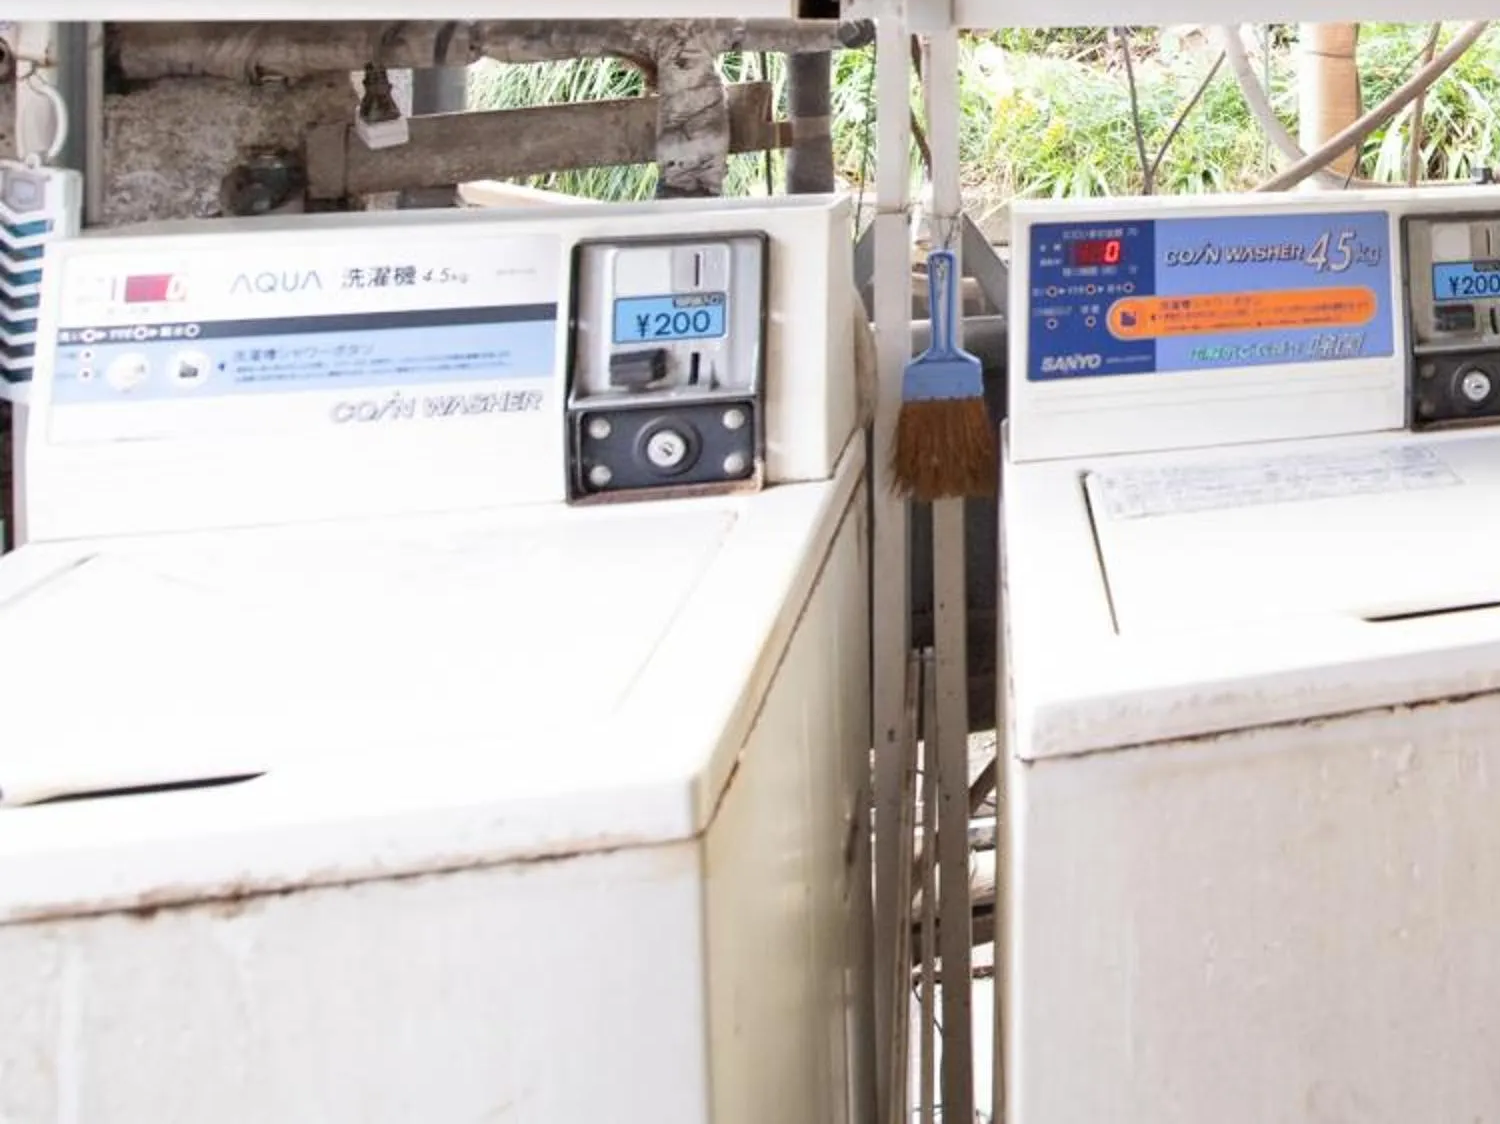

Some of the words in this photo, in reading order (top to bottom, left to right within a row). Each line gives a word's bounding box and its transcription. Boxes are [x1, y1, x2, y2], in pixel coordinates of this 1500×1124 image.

[1103, 240, 1120, 262] 0
[1225, 245, 1304, 264] WASHER
[230, 269, 323, 295] AQUA
[340, 264, 417, 289] 洗濯機
[636, 309, 711, 338] ¥200
[1040, 354, 1102, 372] SANYO
[423, 388, 544, 418] WASHER
